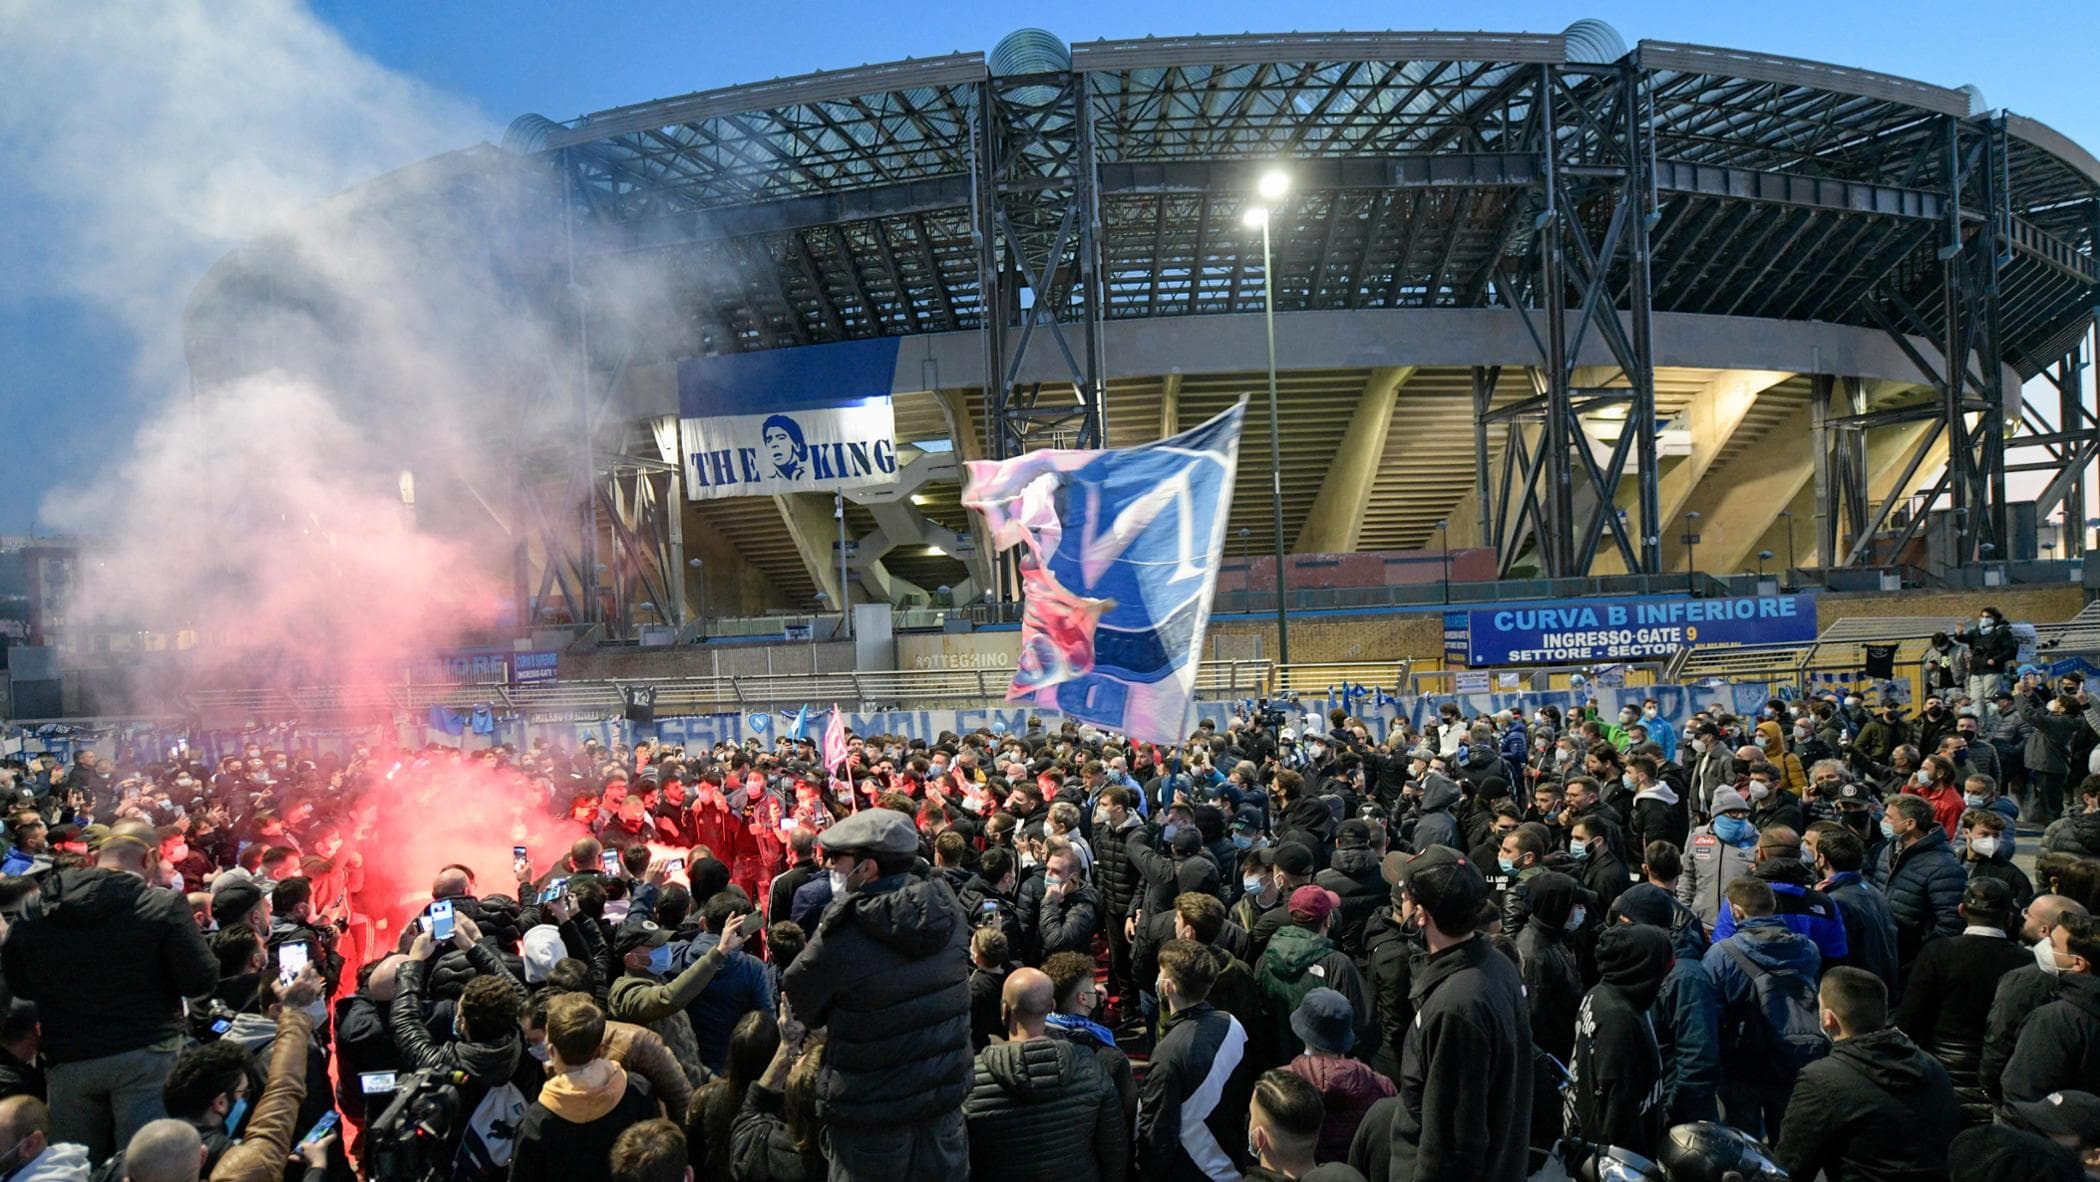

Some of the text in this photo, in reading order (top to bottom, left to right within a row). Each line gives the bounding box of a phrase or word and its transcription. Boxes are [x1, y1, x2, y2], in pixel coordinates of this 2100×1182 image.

[690, 438, 896, 487] THE KING
[1494, 607, 1599, 631] CURVA
[1608, 605, 1628, 627] B
[1637, 597, 1797, 625] INFERIORE
[1686, 626, 1698, 641] 9
[1508, 647, 1594, 662] SETTORE
[1607, 642, 1678, 657] SECTOR
